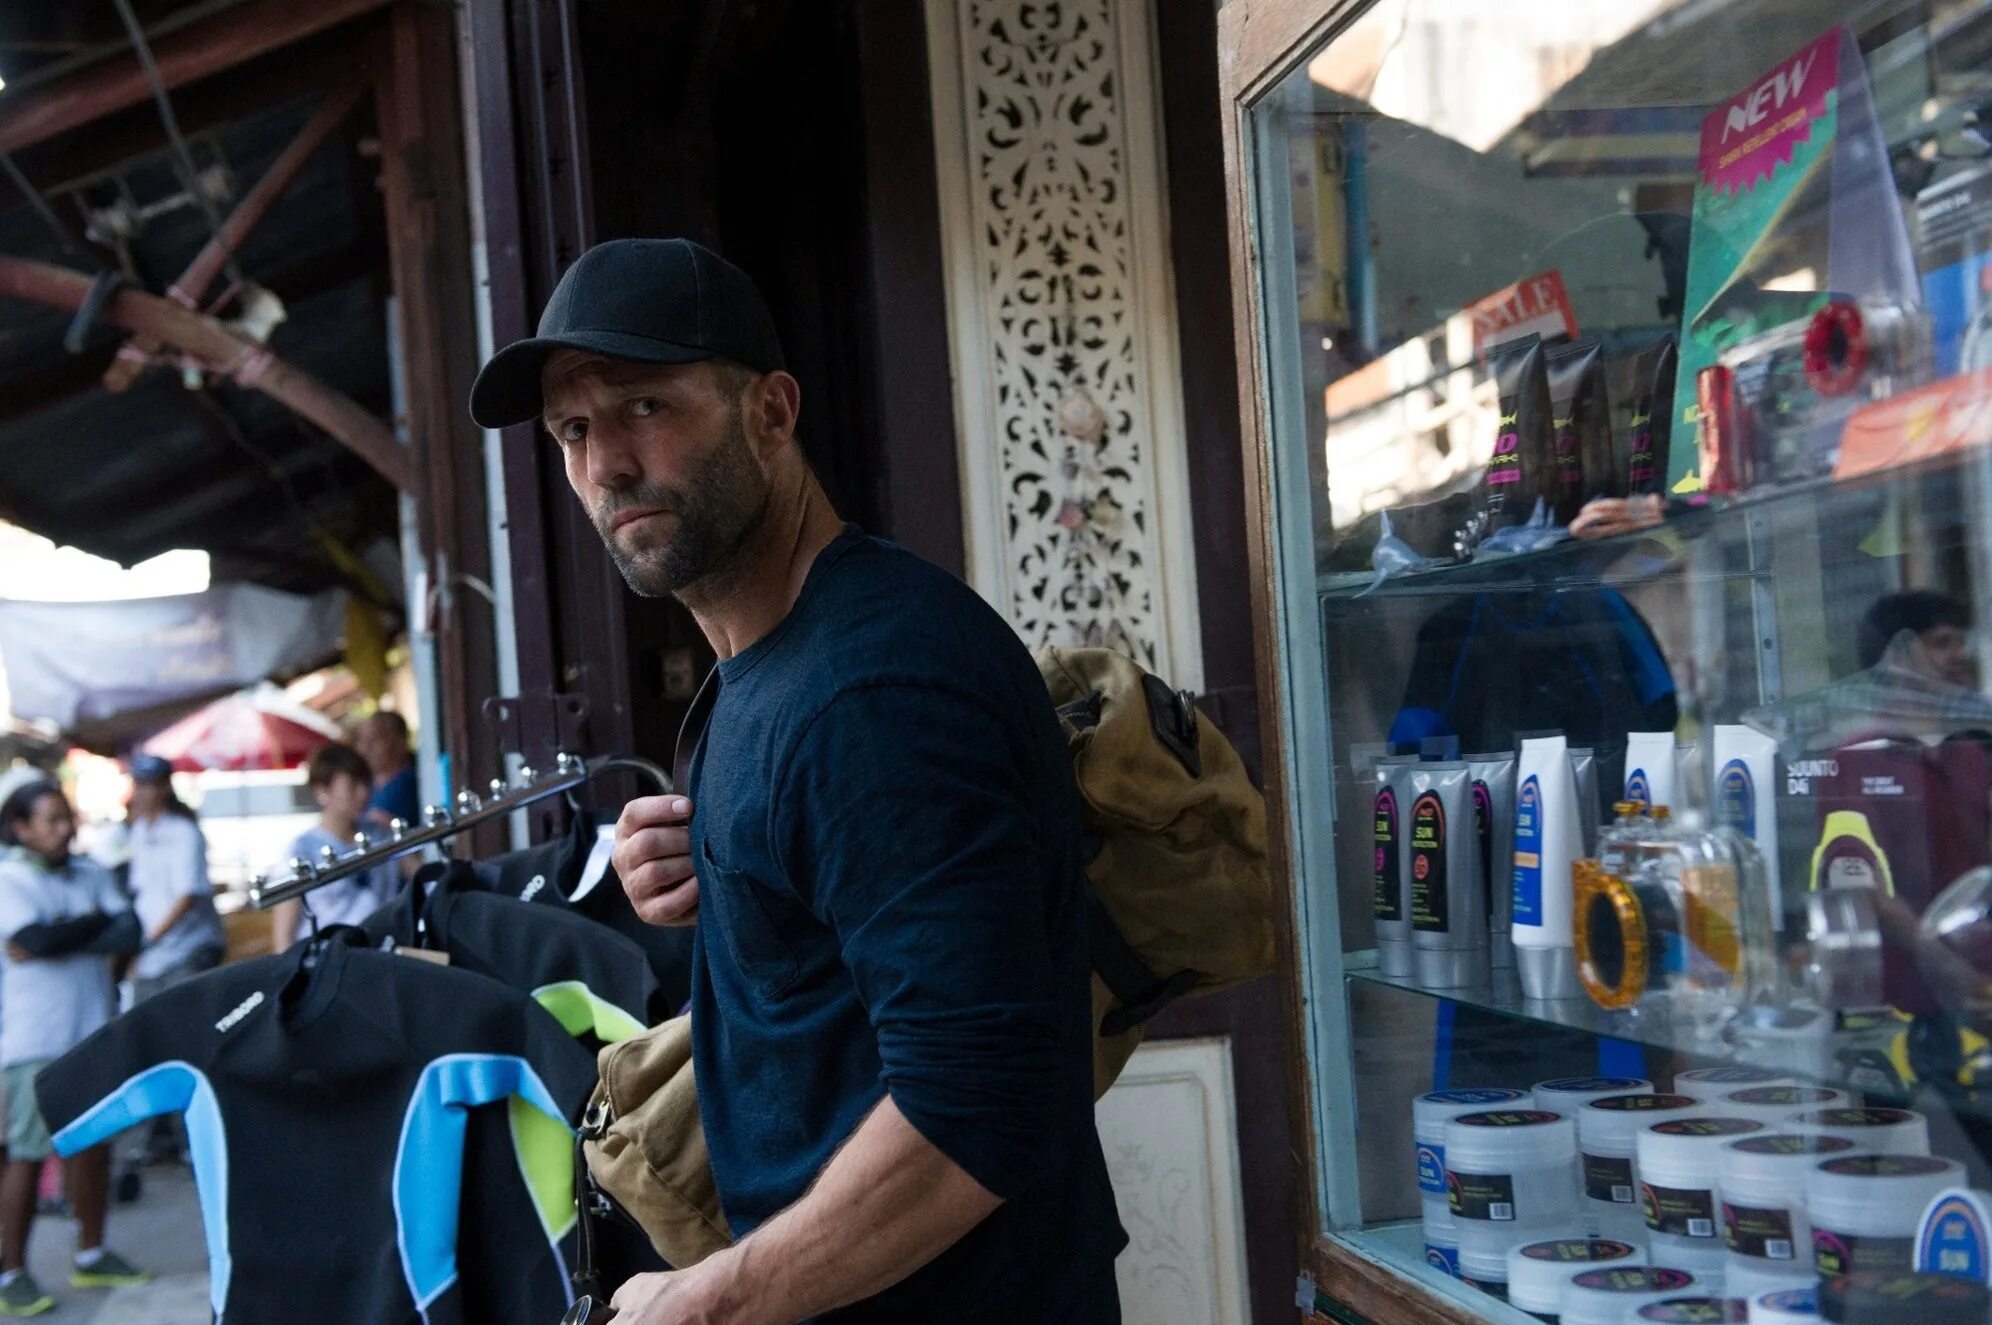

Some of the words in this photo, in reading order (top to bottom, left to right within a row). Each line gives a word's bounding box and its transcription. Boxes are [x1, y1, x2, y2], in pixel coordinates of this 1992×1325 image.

[1720, 47, 1818, 145] NEW
[1476, 278, 1560, 336] SALE
[1787, 759, 1839, 777] SUUNTO
[1415, 826, 1434, 839] SUN
[214, 991, 265, 1033] TRIBORD
